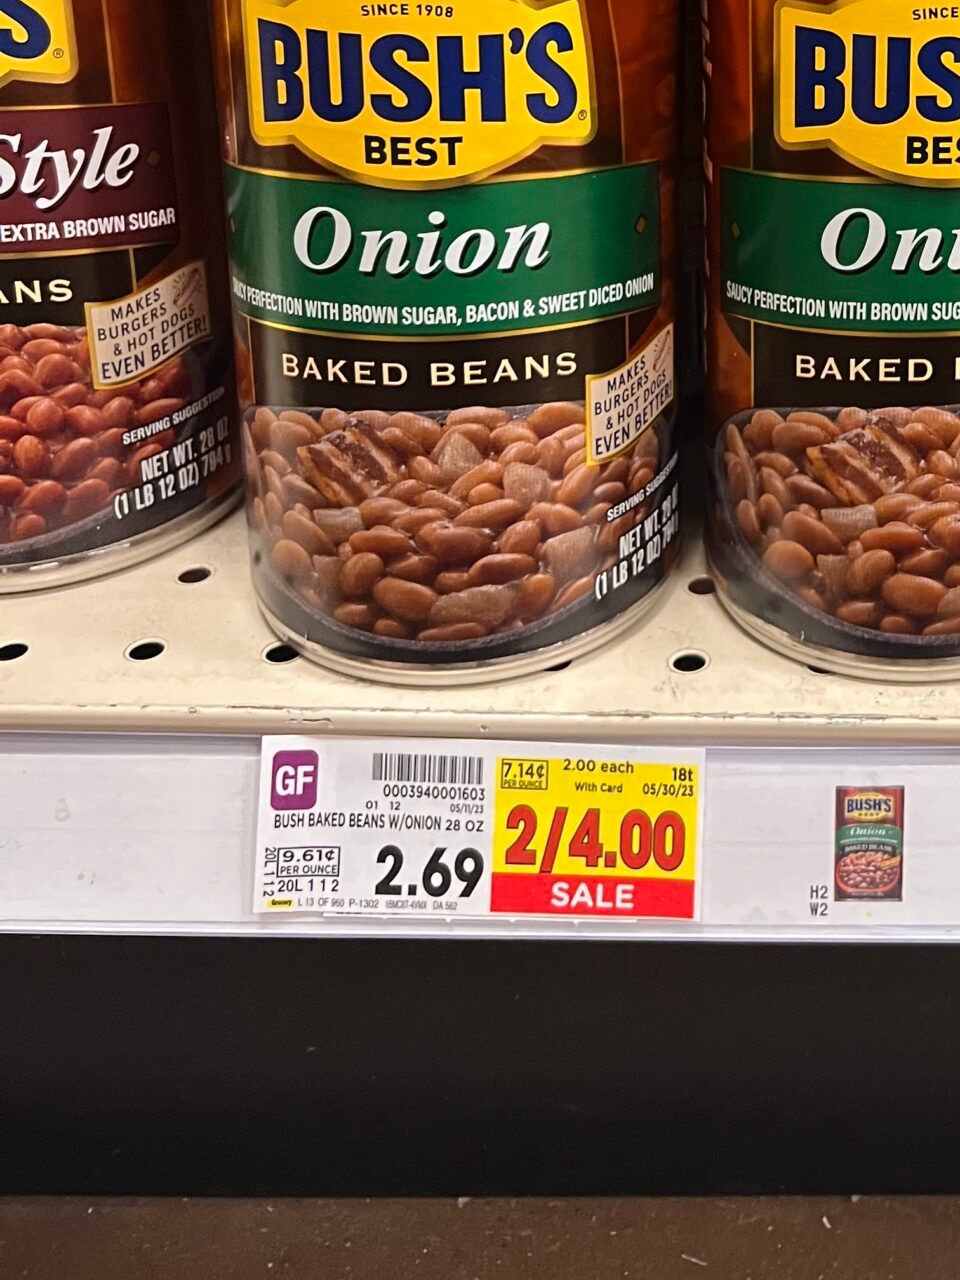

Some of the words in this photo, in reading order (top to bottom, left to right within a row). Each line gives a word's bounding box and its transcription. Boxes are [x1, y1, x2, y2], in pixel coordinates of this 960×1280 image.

[360, 4, 409, 17] SINCE
[416, 4, 454, 18] 1908
[912, 6, 959, 20] SINCE
[258, 18, 577, 124] BUSH'S
[364, 135, 463, 166] BEST
[0, 125, 139, 209] Style
[1, 222, 58, 242] EXTRA
[64, 215, 125, 239] BROWN
[129, 207, 176, 230] SUGAR
[293, 206, 552, 276] Onion
[111, 288, 161, 321] MAKES
[98, 304, 167, 341] BURGERS
[113, 343, 122, 356] &
[128, 327, 154, 352] HOT
[161, 303, 196, 334] DOGS
[102, 352, 146, 380] EVEN
[151, 315, 208, 361] BETTER!
[281, 353, 408, 387] BAKED
[430, 351, 578, 387] BEANS
[796, 354, 933, 383] BAKED
[275, 765, 315, 796] GF
[503, 763, 545, 778] 7.14¢
[563, 759, 596, 772] 2.00
[601, 761, 634, 774] each
[672, 768, 693, 782] 18t
[383, 784, 485, 801] 0003940001603
[504, 780, 517, 788] PER
[518, 780, 543, 789] OUNCE
[575, 781, 598, 792] With
[600, 783, 623, 793] Card
[642, 783, 694, 797] 05/30/23
[366, 800, 378, 810] 01
[390, 801, 401, 811] 12
[450, 803, 484, 814] 05/11/23
[847, 798, 891, 813] BUSH'S
[274, 813, 304, 829] BUSH
[309, 812, 345, 828] BAKED
[350, 814, 385, 829] BEANS
[389, 815, 441, 831] W/ONION
[446, 819, 460, 831] 28
[465, 820, 484, 832] OZ
[505, 804, 686, 874] 2/4.00
[282, 849, 336, 863] 9.61¢
[280, 865, 299, 875] PER
[302, 864, 337, 874] OUNCE
[375, 844, 484, 898] 2.69
[278, 879, 303, 892] 20L
[550, 881, 635, 909] SALE
[810, 885, 828, 899] H2
[810, 902, 828, 916] W2
